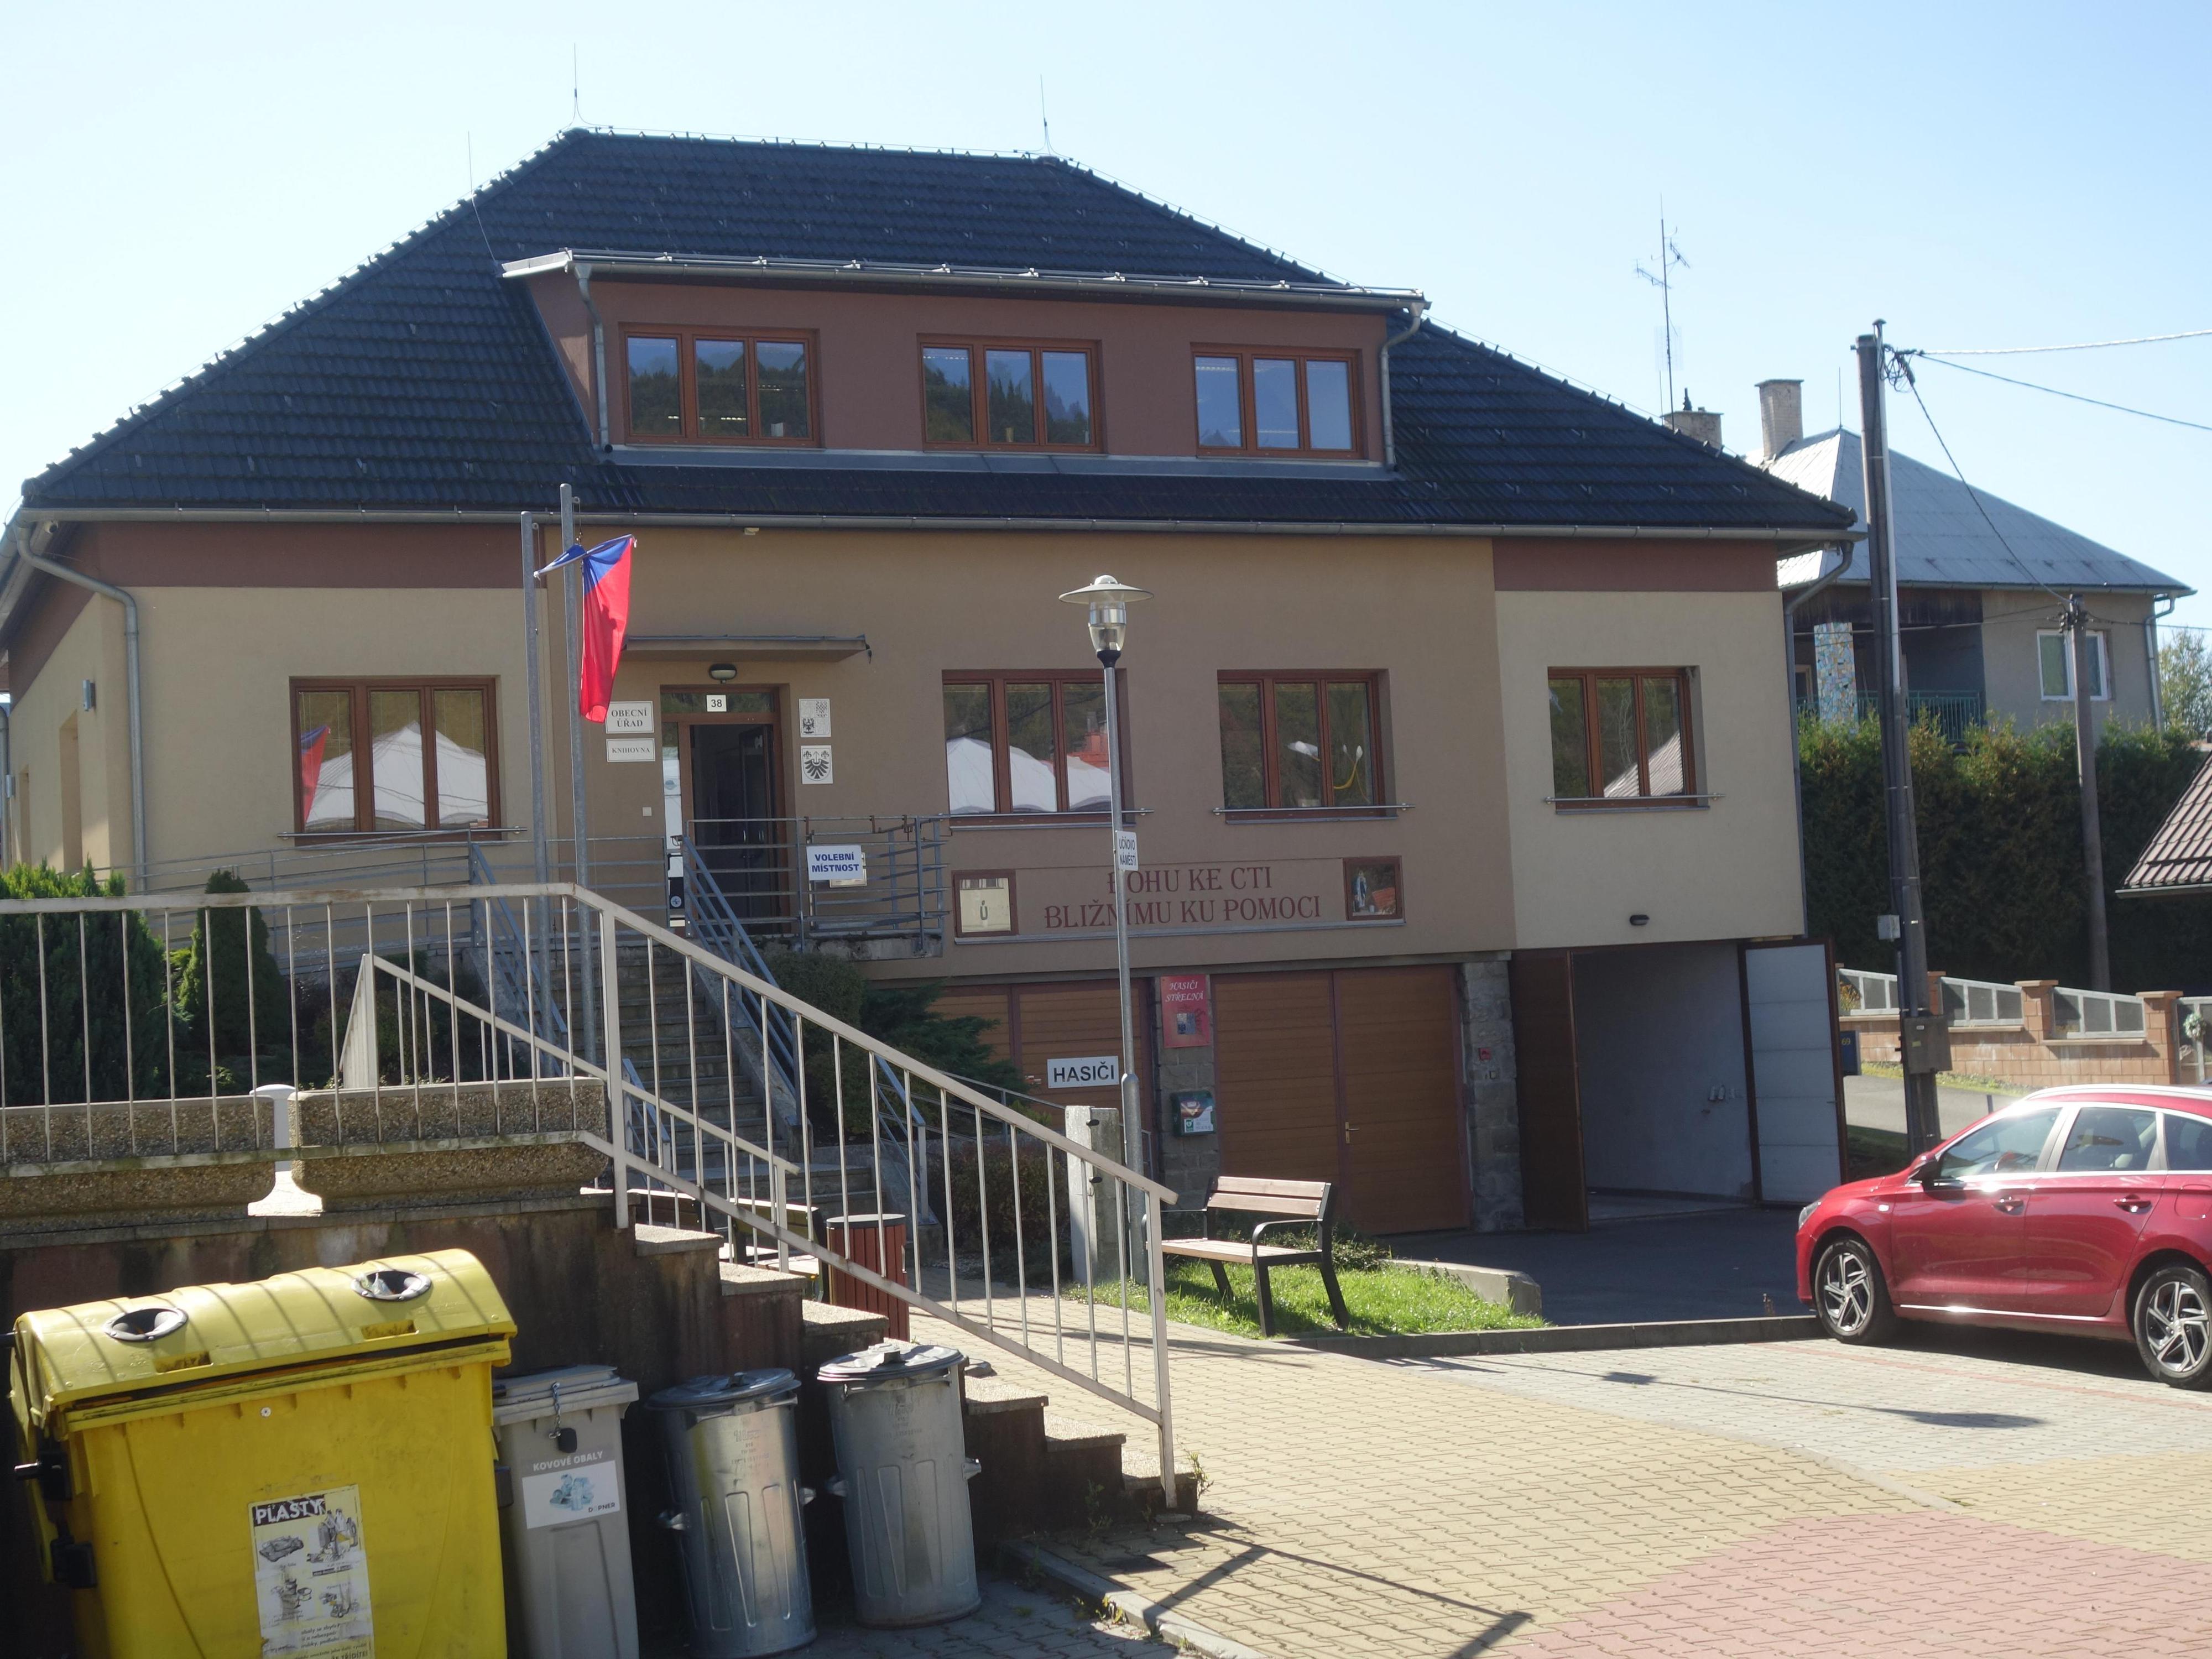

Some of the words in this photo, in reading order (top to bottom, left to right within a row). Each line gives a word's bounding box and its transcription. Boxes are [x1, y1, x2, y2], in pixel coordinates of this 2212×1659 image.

[711, 699, 722, 708] 38
[611, 707, 647, 717] OBECNÍ
[617, 718, 643, 728] ÚŘAD
[815, 852, 854, 862] VOLEBNÍ
[812, 863, 859, 873] MÍSTNOST
[1188, 868, 1222, 892] KE
[1230, 867, 1272, 890] CTI
[1181, 900, 1215, 923] KU
[1223, 895, 1321, 921] POMOCI
[1169, 980, 1198, 991] HASIČI
[1165, 991, 1204, 1003] STŘELNÁ
[1053, 1061, 1114, 1083] HASIČI
[533, 1455, 572, 1472] KOVOVÉ
[573, 1451, 603, 1464] OBALY
[255, 1498, 325, 1525] PLASTY
